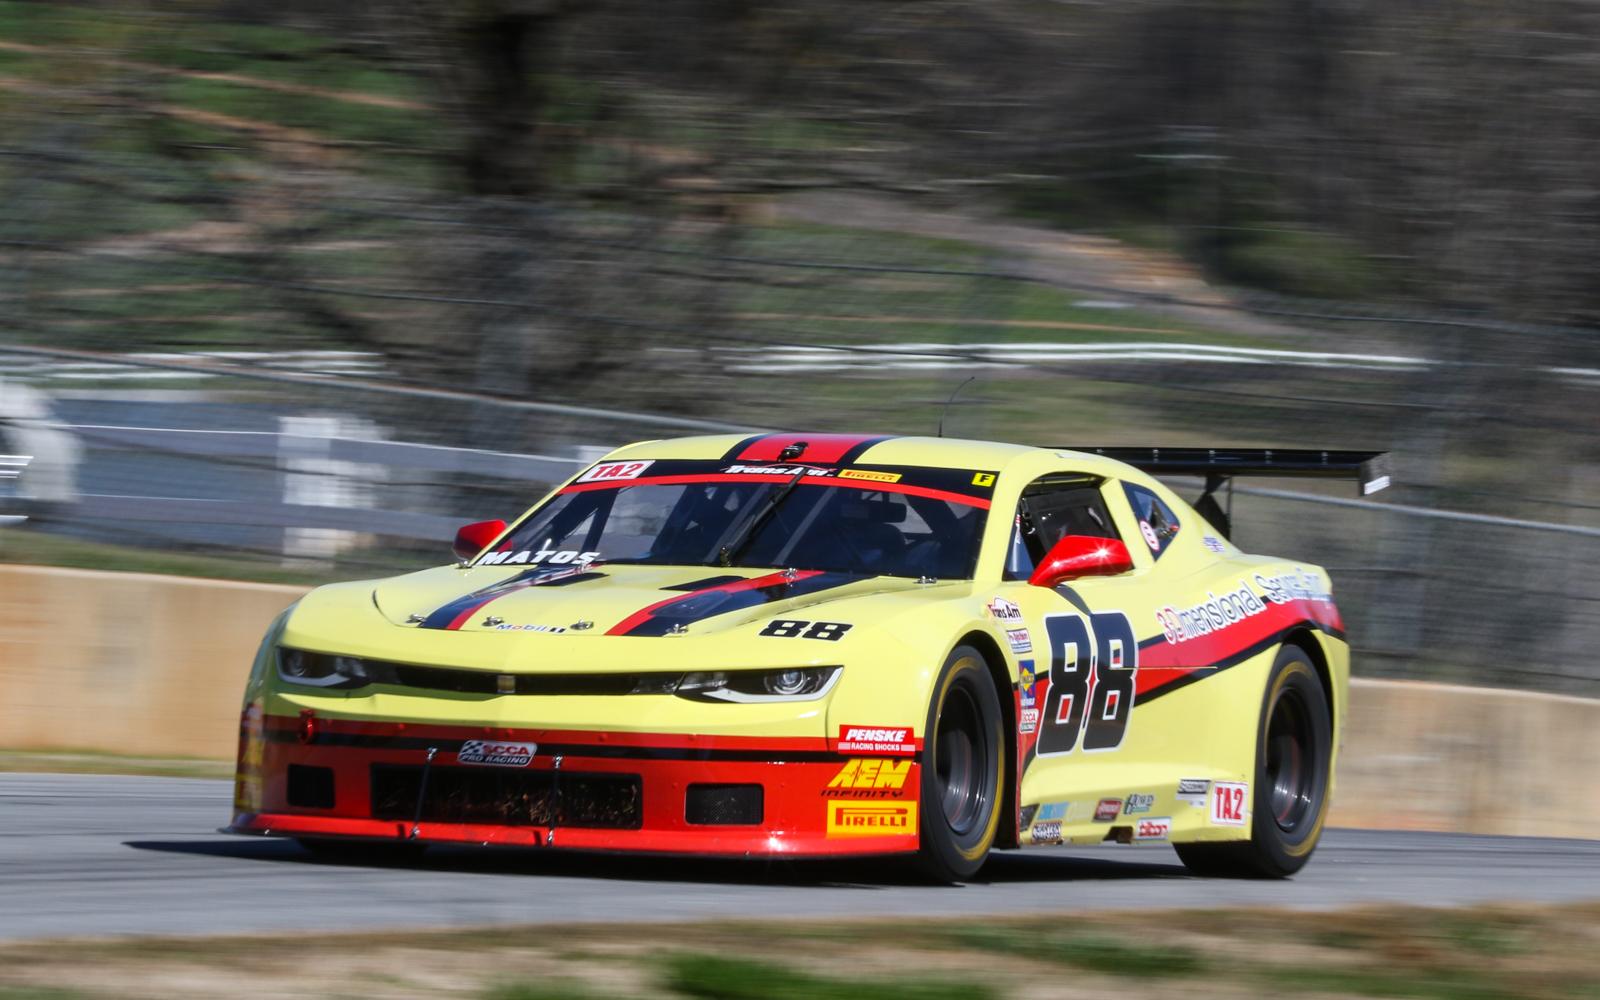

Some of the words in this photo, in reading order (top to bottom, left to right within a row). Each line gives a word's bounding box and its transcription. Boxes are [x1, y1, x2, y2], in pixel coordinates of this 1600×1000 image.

[591, 463, 645, 479] TA2
[845, 470, 896, 481] PIRELLI
[980, 474, 991, 483] F
[478, 550, 600, 565] MATOS
[496, 624, 547, 632] Mobil
[759, 620, 853, 641] 88
[1037, 611, 1137, 757] 88
[845, 729, 906, 742] PENSKE
[483, 744, 529, 756] SCCA
[851, 743, 874, 751] RACING
[875, 743, 900, 751] SHOCKS
[462, 753, 484, 761] PRO
[485, 756, 528, 764] RACING
[827, 758, 912, 789] AEM
[1215, 787, 1244, 820] TA2
[835, 807, 908, 827] PIRELLI
